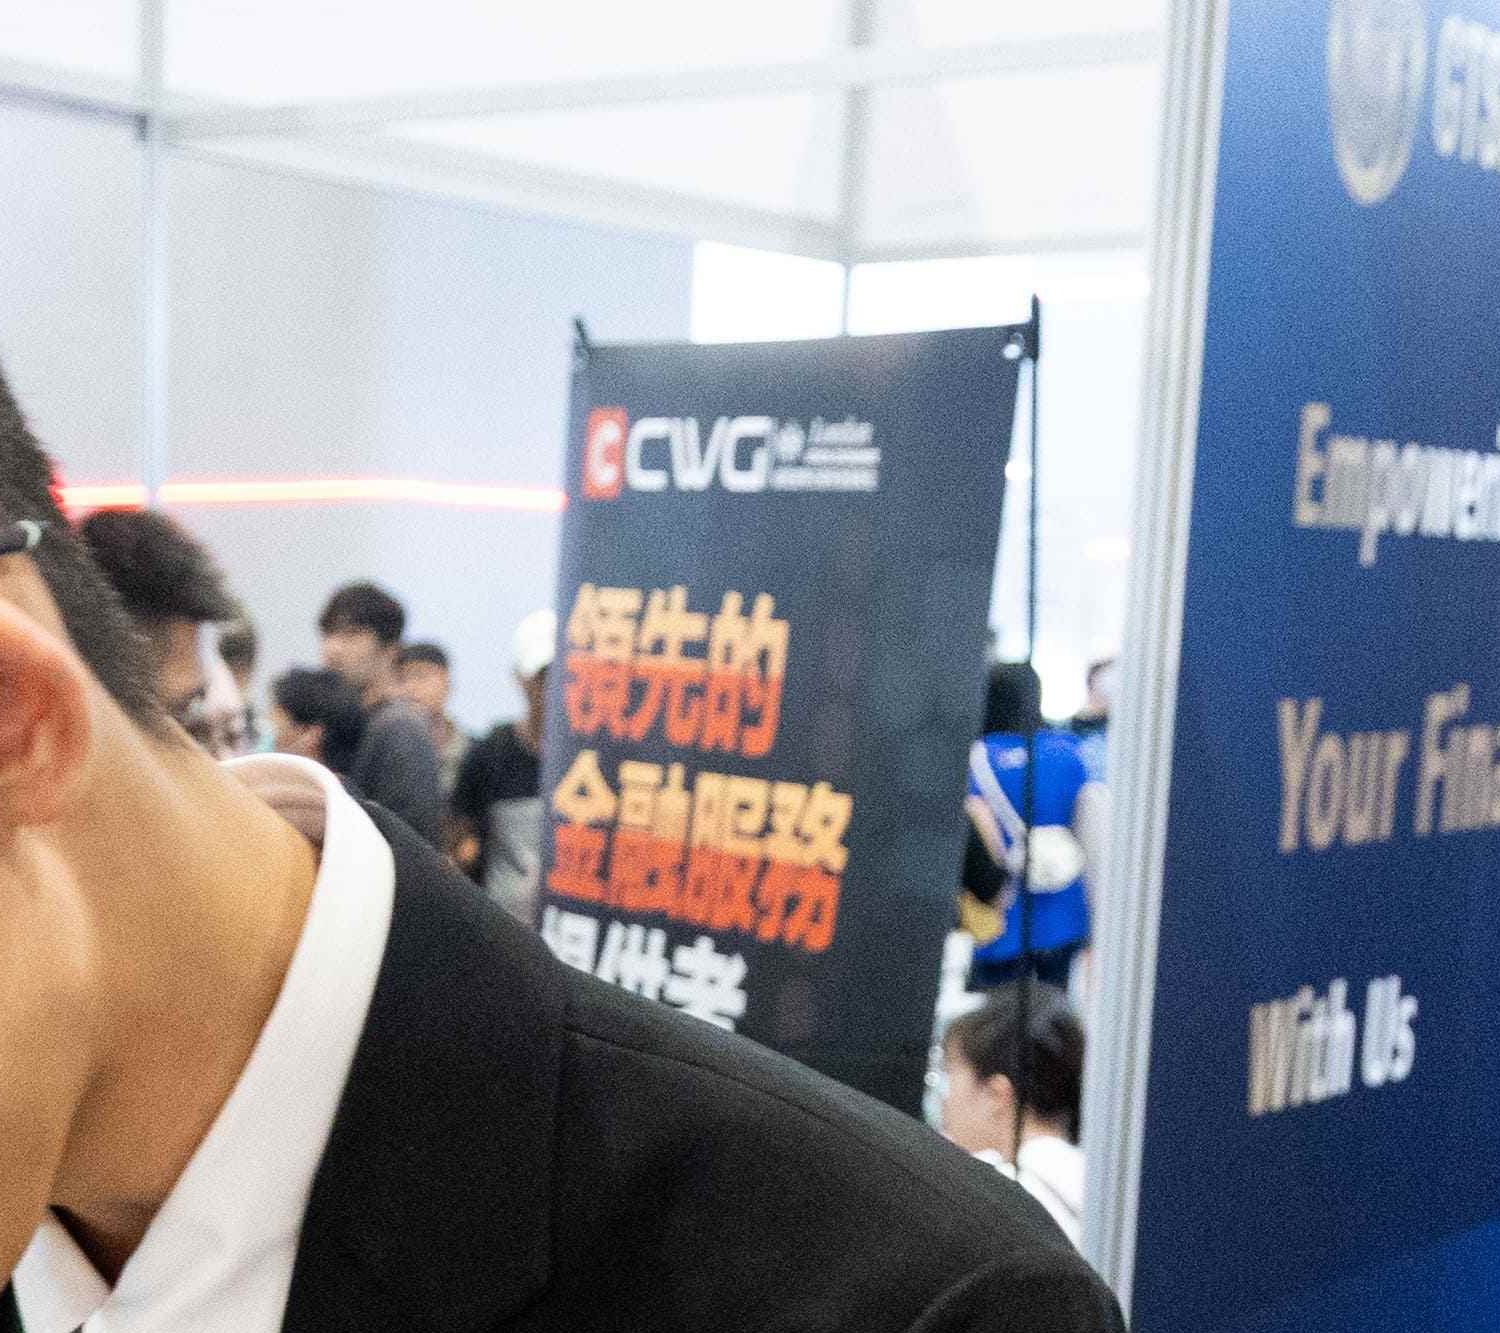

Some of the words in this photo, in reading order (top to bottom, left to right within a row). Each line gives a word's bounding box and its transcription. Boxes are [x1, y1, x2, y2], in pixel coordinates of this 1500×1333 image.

[1277, 696, 1408, 854] Your
[1247, 978, 1358, 1116] With
[1361, 974, 1419, 1088] Us
